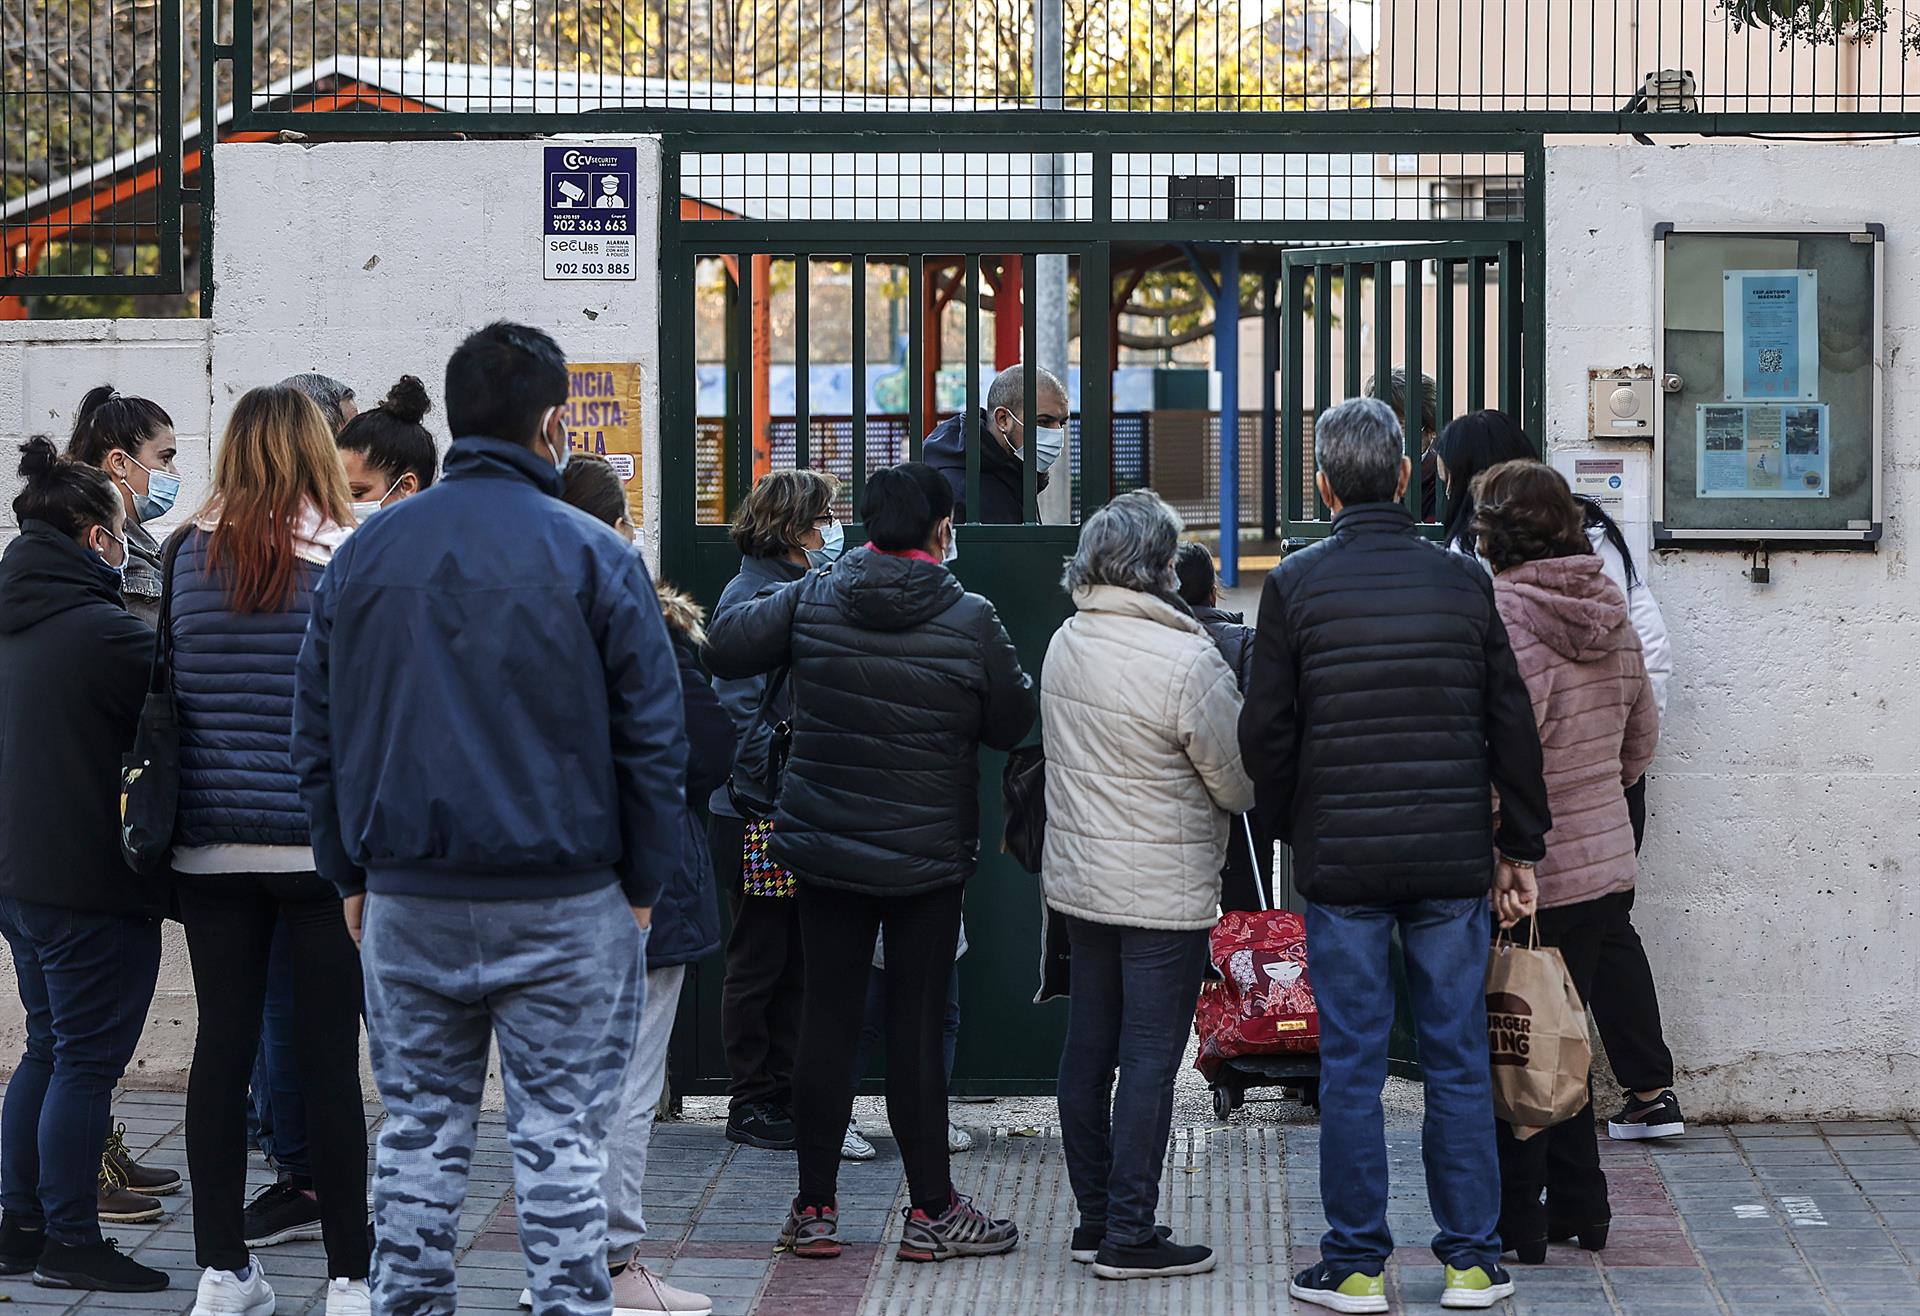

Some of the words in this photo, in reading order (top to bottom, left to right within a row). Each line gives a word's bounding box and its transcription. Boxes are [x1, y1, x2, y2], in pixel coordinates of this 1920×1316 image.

[553, 220, 575, 231] 902
[578, 220, 601, 231] 363
[605, 220, 627, 231] 663
[556, 264, 577, 274] 902
[582, 264, 603, 274] 503
[608, 264, 630, 274] 885
[567, 372, 614, 396] NCIA
